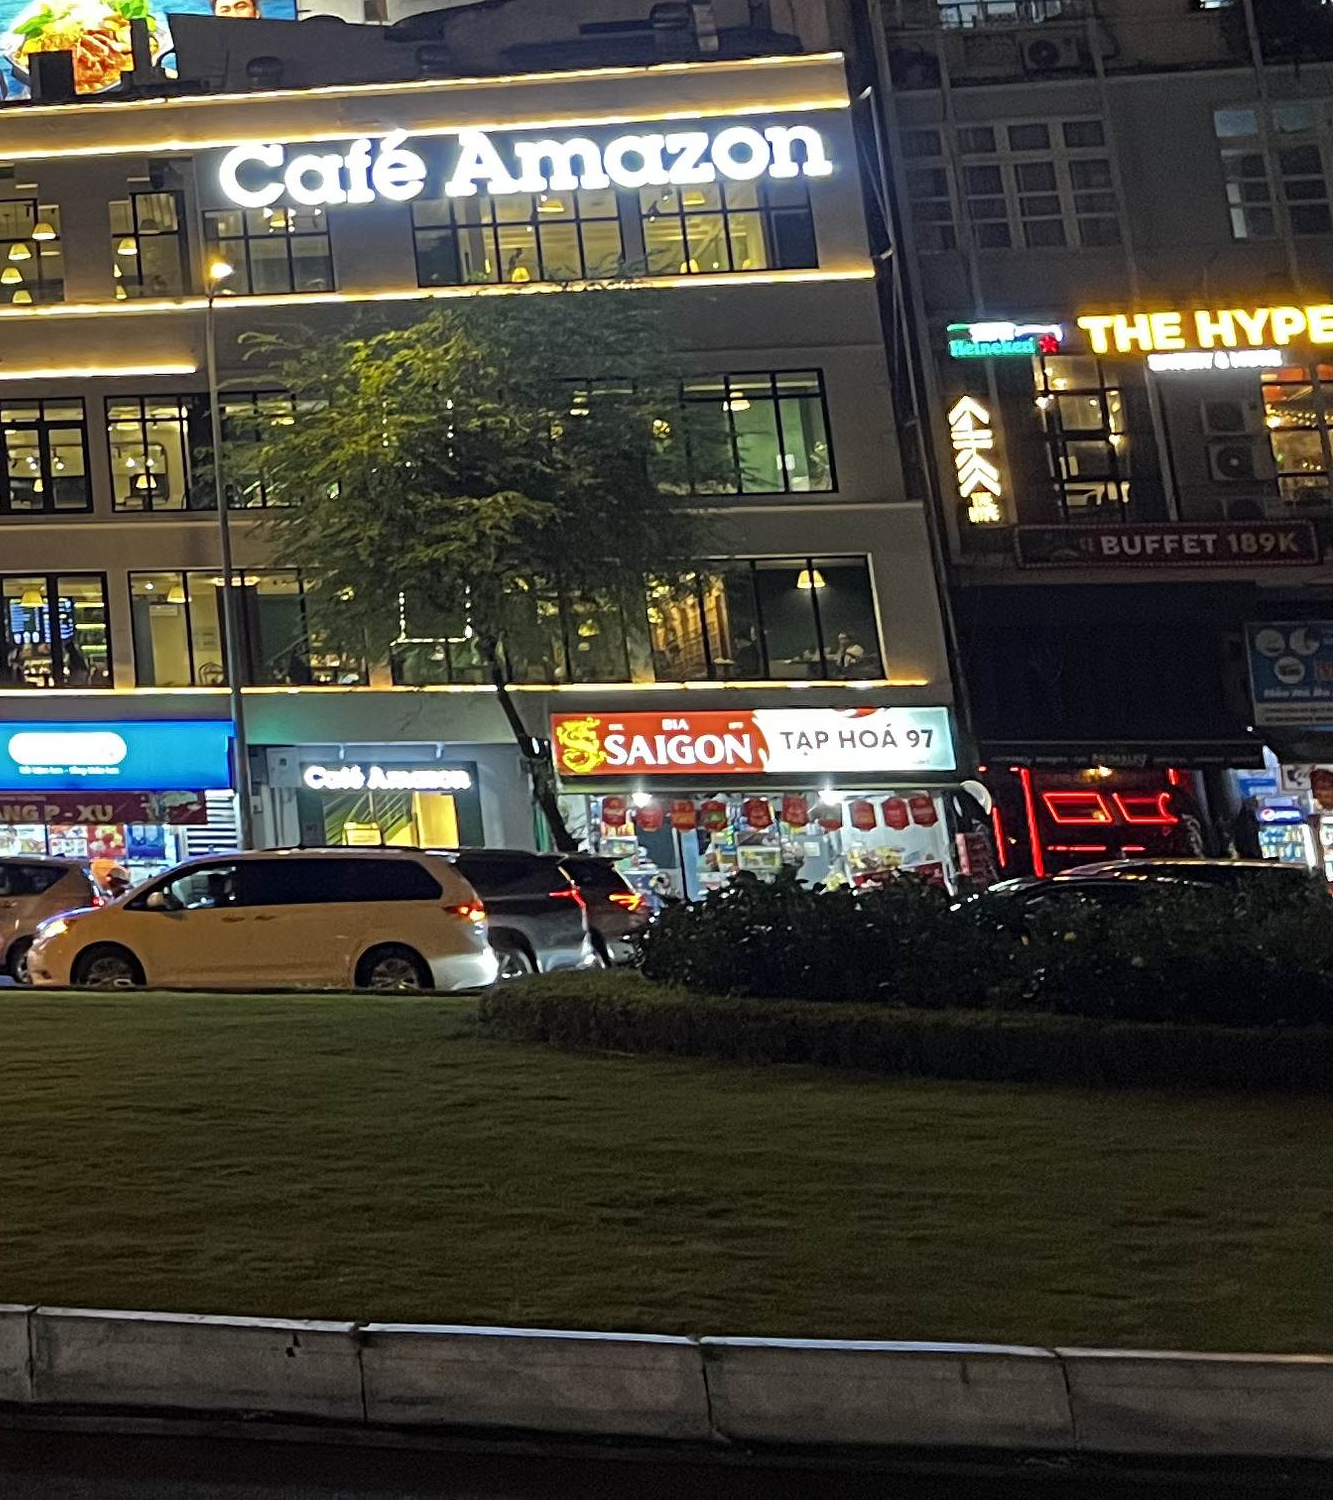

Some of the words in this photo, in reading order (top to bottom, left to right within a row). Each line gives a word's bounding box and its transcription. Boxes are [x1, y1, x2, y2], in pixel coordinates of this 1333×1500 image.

[219, 130, 427, 208] Café
[445, 125, 834, 197] Amazon
[1077, 312, 1186, 355] THE
[1194, 304, 1333, 352] HYPE
[1101, 534, 1218, 555] BUFFET
[1228, 531, 1299, 553] 189K
[603, 733, 753, 765] SAIGON
[780, 731, 829, 756] TẠP
[838, 723, 899, 749] HOÁ
[906, 729, 933, 749] 97
[78, 805, 115, 822] XU
